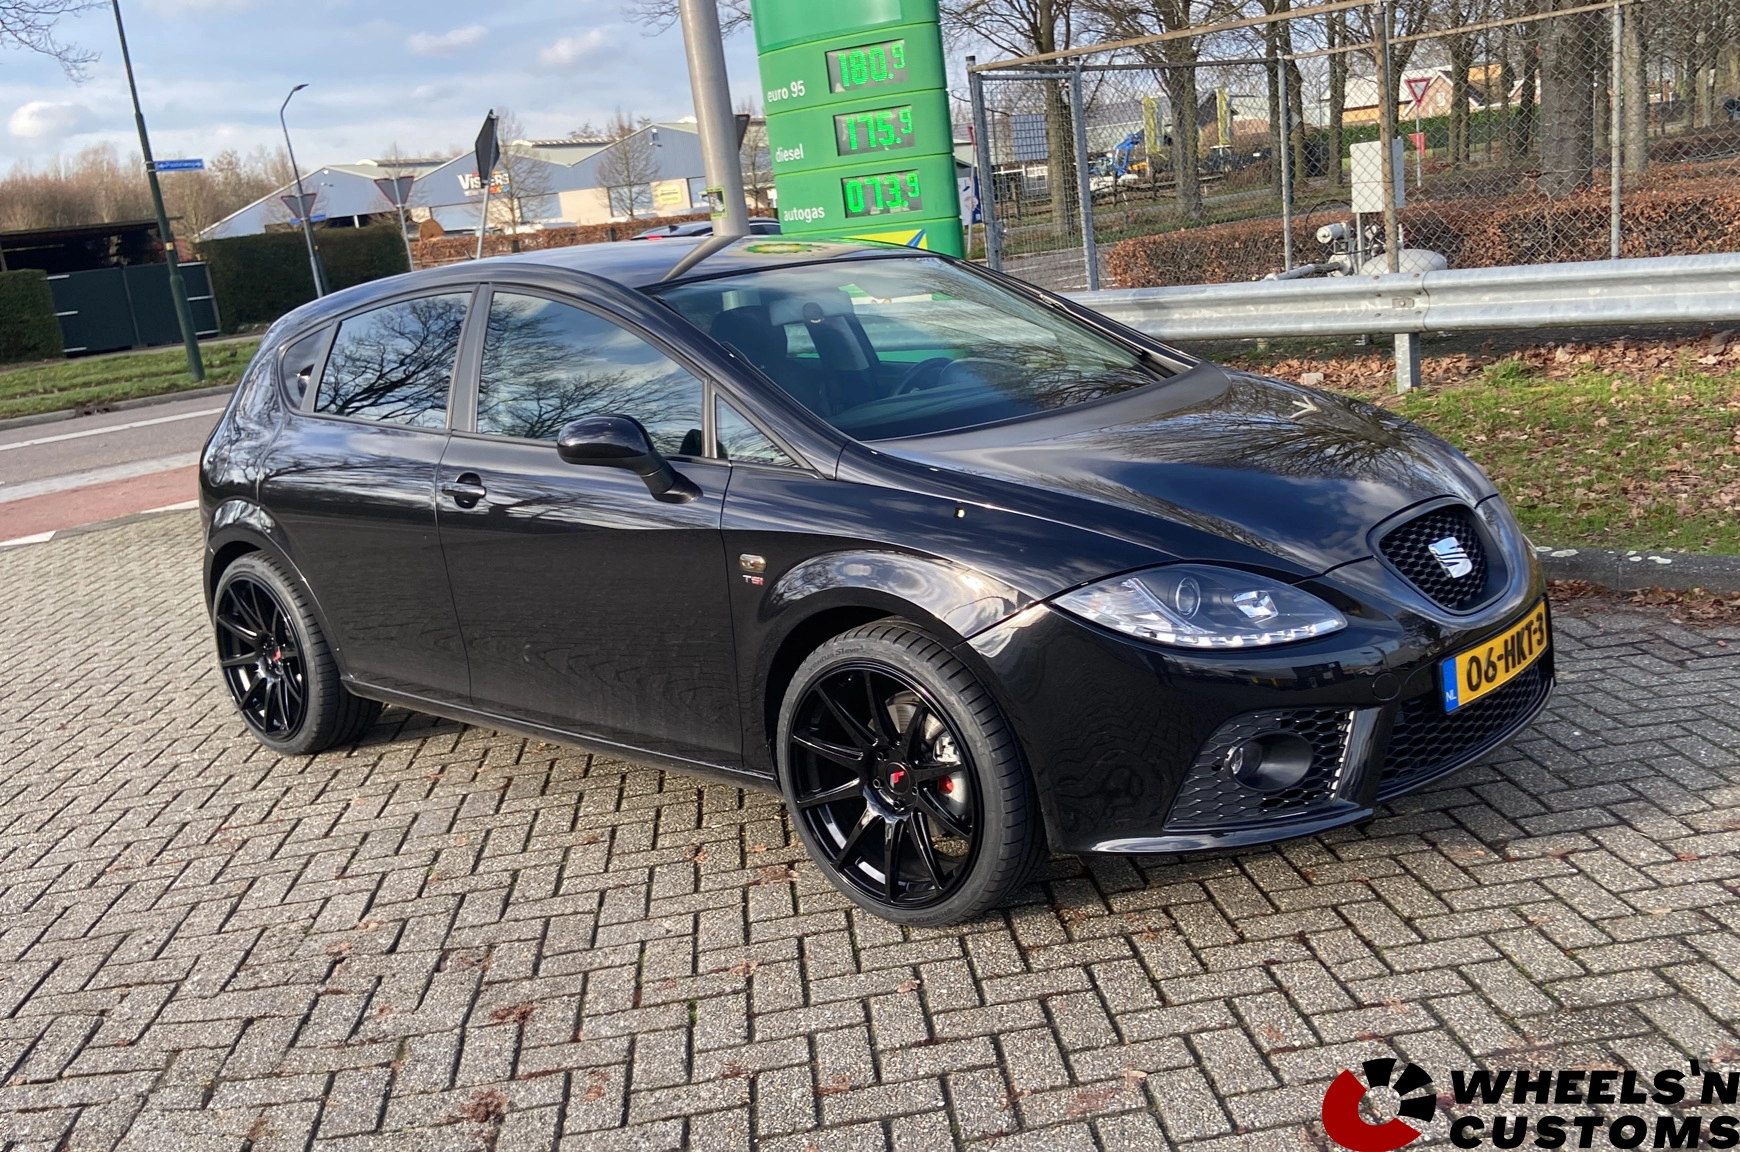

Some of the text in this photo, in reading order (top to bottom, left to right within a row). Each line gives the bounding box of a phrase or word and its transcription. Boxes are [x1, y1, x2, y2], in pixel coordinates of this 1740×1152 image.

[837, 43, 906, 87] 180.9
[767, 80, 806, 103] euro 95
[846, 108, 913, 150] 175.9
[775, 143, 805, 163] diesel
[845, 172, 920, 213] 073.9
[783, 206, 825, 223] autogas
[1466, 611, 1545, 692] 06-HKT-3
[1445, 689, 1457, 702] NL
